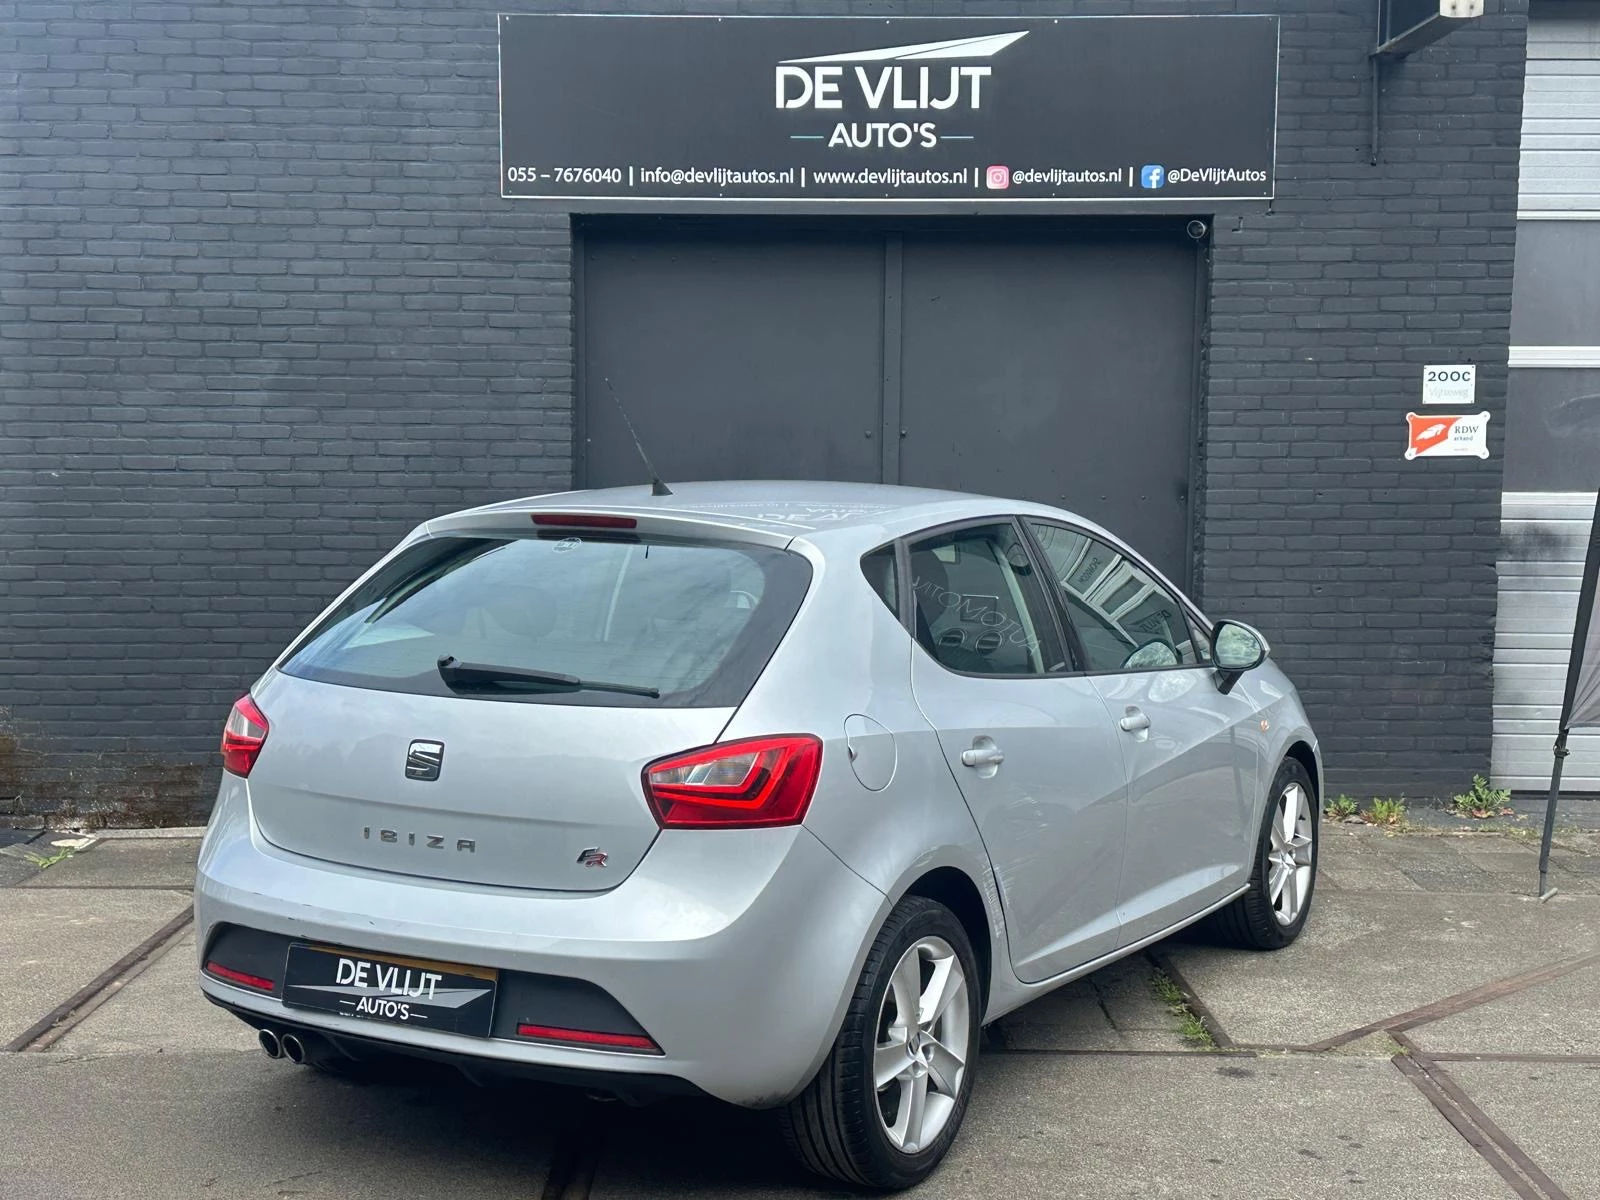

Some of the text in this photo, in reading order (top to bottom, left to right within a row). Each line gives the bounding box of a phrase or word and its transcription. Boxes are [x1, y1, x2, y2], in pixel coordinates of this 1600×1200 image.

[775, 66, 992, 110] DE VLIJT
[828, 122, 937, 148] AUTO'S
[508, 167, 537, 182] 055
[554, 168, 622, 183] 7676040
[640, 167, 794, 187] info@devlijtautos.nl
[813, 167, 968, 187] www.devlijtautos.nl
[1012, 168, 1122, 186] @devlijtautos.nl
[1167, 168, 1267, 185] @DeVlijtAutos
[1454, 425, 1479, 434] RDW
[363, 826, 476, 853] IBIZA
[336, 958, 443, 1000] DE VLIJT
[356, 996, 410, 1020] AUTO'S
